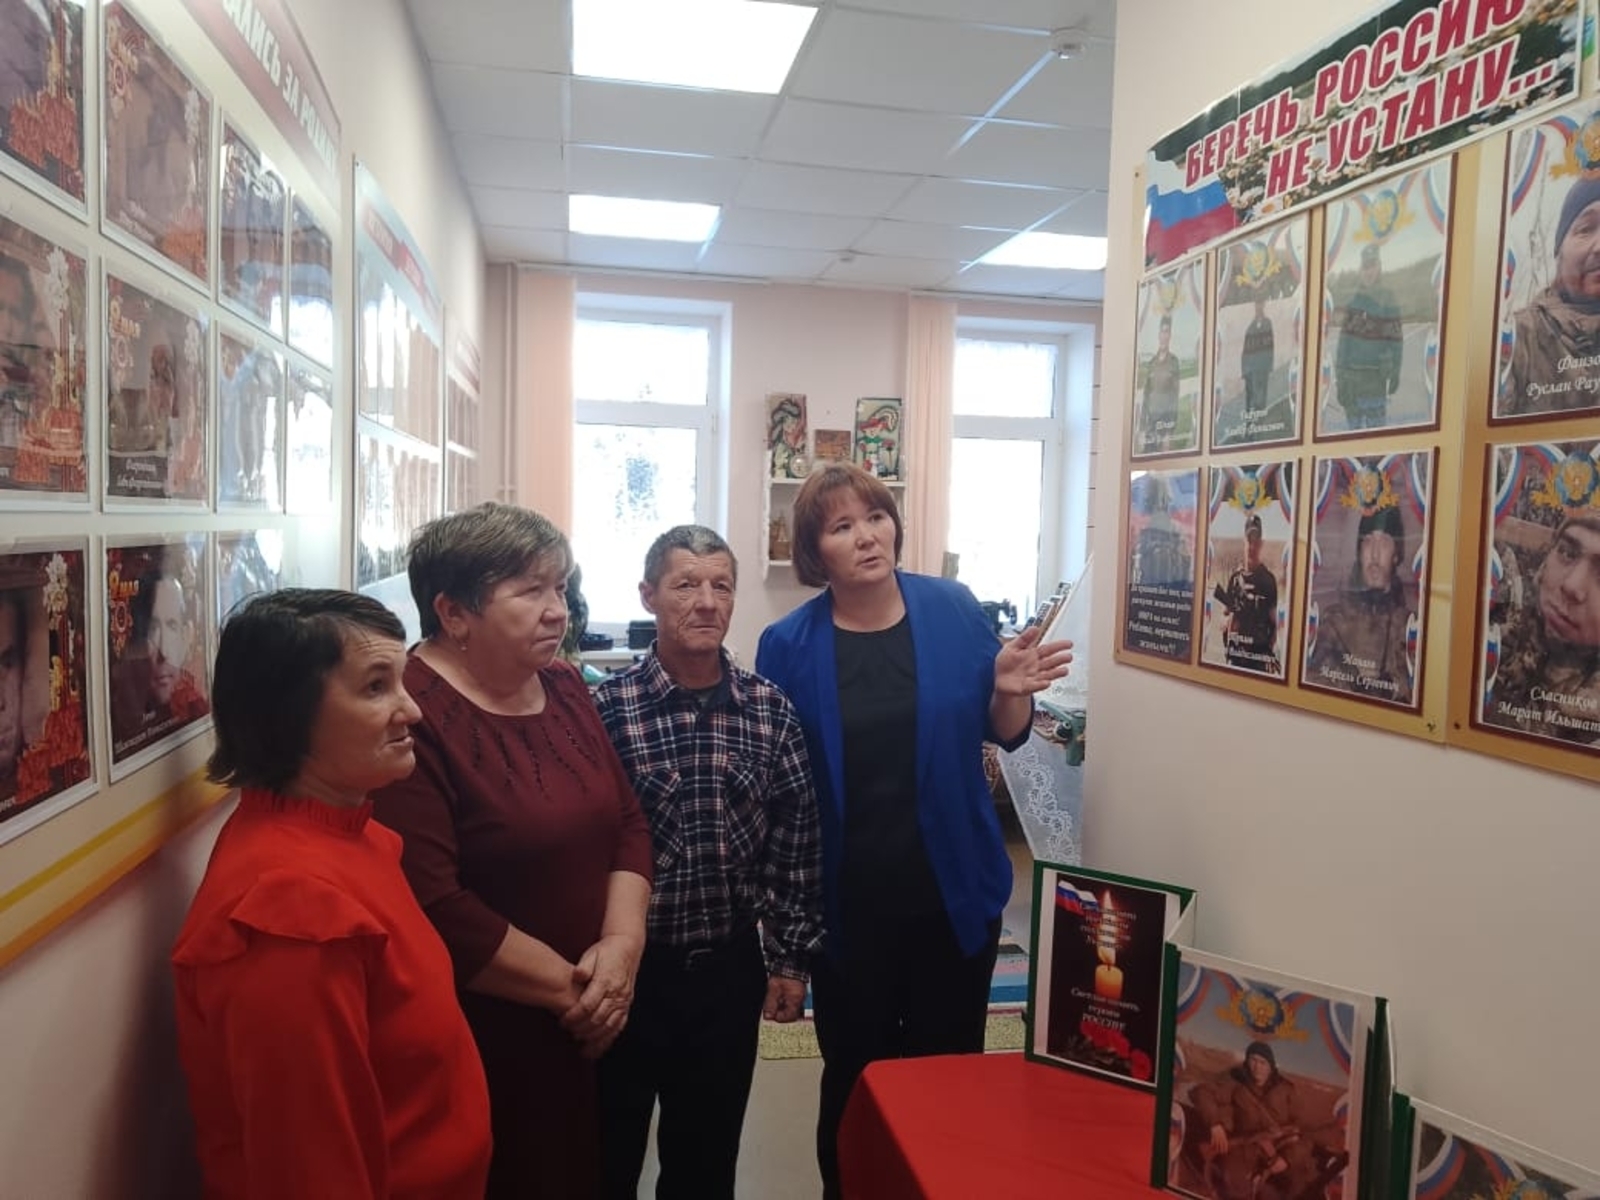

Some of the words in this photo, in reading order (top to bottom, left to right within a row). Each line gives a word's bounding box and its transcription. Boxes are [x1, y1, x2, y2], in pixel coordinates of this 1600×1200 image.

[282, 61, 300, 118] ЗА
[1185, 87, 1300, 189] БЕРЕЧЬ
[1314, 0, 1527, 119] РОССИЮ
[1265, 136, 1315, 199] НЕ
[1326, 34, 1557, 175] УСТАНУ...
[1498, 701, 1542, 723] Марат
